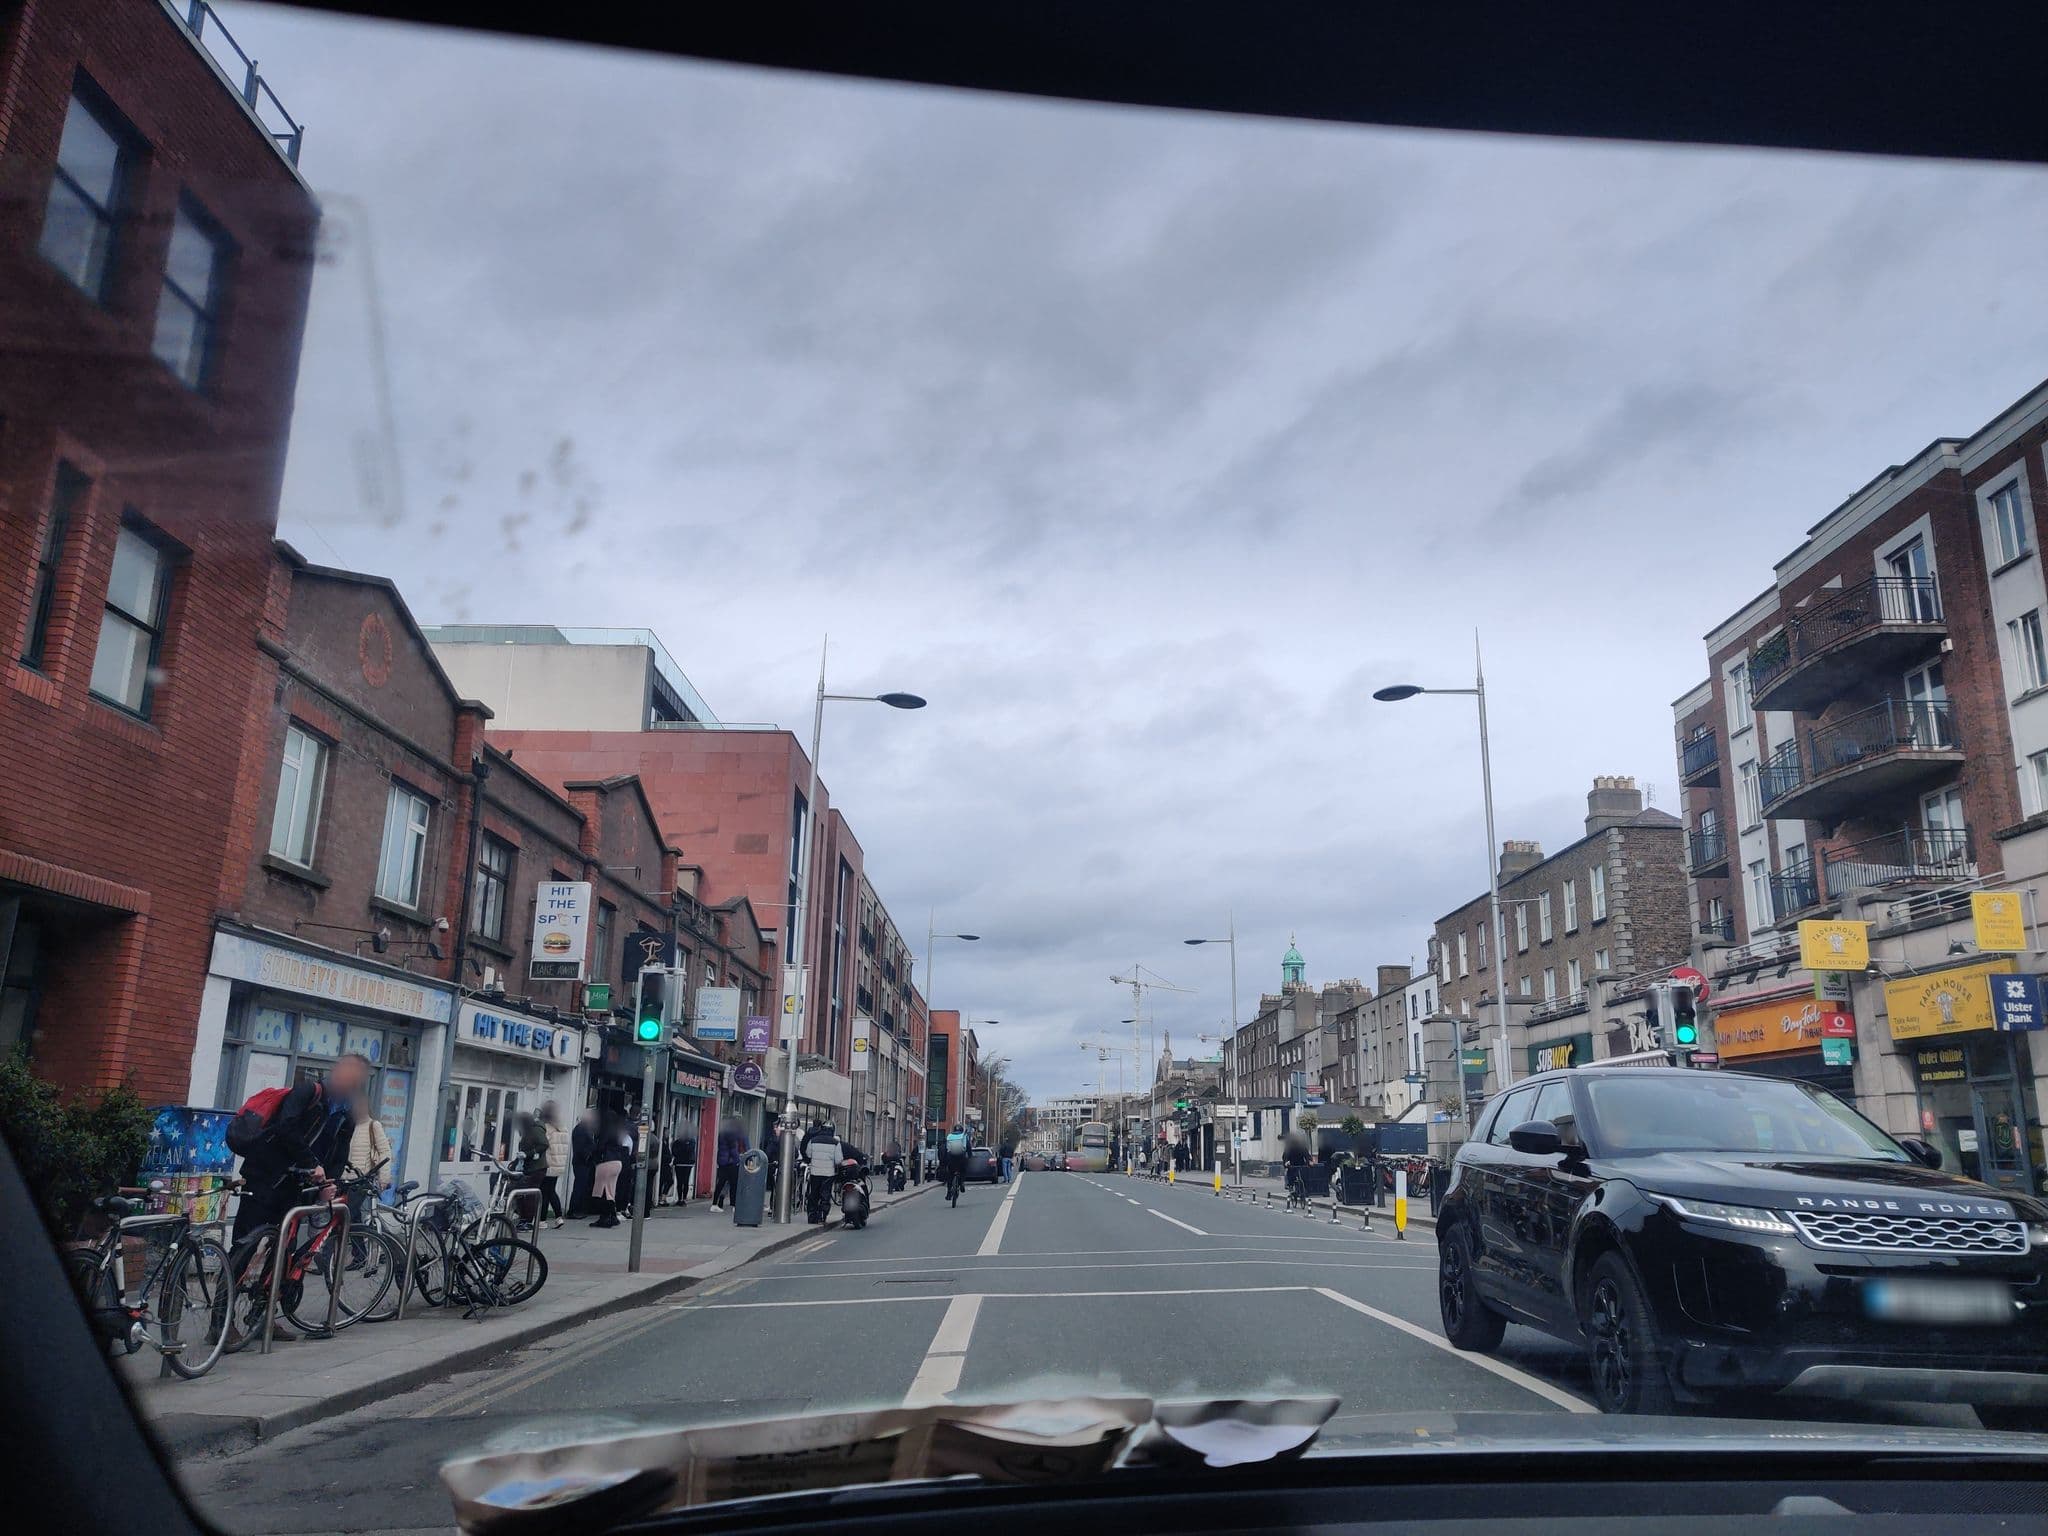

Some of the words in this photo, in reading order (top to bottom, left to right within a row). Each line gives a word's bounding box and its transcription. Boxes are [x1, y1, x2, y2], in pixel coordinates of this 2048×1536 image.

[551, 886, 574, 897] HIT
[548, 899, 577, 909] THE
[1812, 926, 1834, 942] TADKA
[1836, 926, 1861, 942] HOUSE
[1920, 981, 1940, 1008] TADKA
[1943, 978, 1973, 1003] HOUSE
[2003, 1001, 2033, 1013] Ulster
[747, 1019, 769, 1027] CAMILE
[2008, 1013, 2033, 1024] Bank
[473, 1012, 501, 1039] HIT
[501, 1018, 532, 1048] THE
[1536, 1043, 1573, 1072] SUBWAY
[735, 1074, 760, 1082] CAMILE
[1796, 1197, 1900, 1211] RANGE
[1918, 1203, 2009, 1216] ROVER
